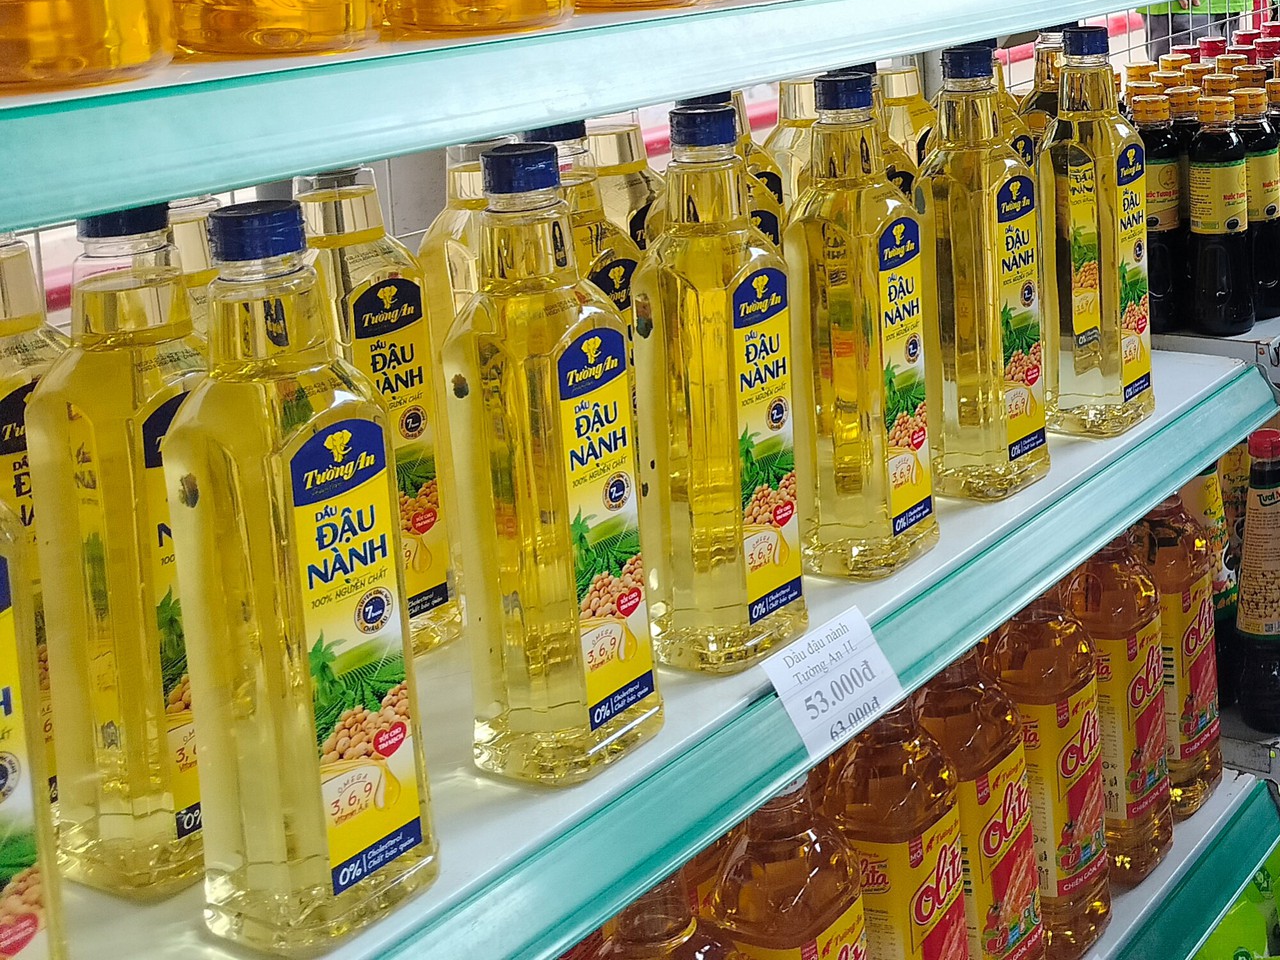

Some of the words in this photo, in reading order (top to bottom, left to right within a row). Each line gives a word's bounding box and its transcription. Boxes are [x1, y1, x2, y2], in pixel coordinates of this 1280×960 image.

[1001, 248, 1035, 275] NÀNH
[888, 274, 915, 304] ĐẬU
[884, 296, 920, 329] NÀNH
[371, 343, 415, 373] ĐẬU
[745, 332, 780, 363] ĐẬU
[739, 357, 787, 392] NÀNH
[575, 400, 618, 438] ĐẬU
[569, 426, 628, 471] NÀNH
[303, 460, 355, 490] Tường
[352, 451, 376, 474] An
[315, 504, 338, 521] DẦU
[315, 504, 376, 551] ĐẬU
[308, 533, 388, 590] NÀNH
[782, 648, 807, 669] Dầu
[807, 639, 826, 658] đậu
[825, 622, 850, 644] nành
[792, 659, 829, 686] Tường
[828, 649, 844, 666] An
[804, 659, 877, 720] 53.000đ
[593, 701, 611, 724] 0%
[339, 860, 362, 887] 0%
